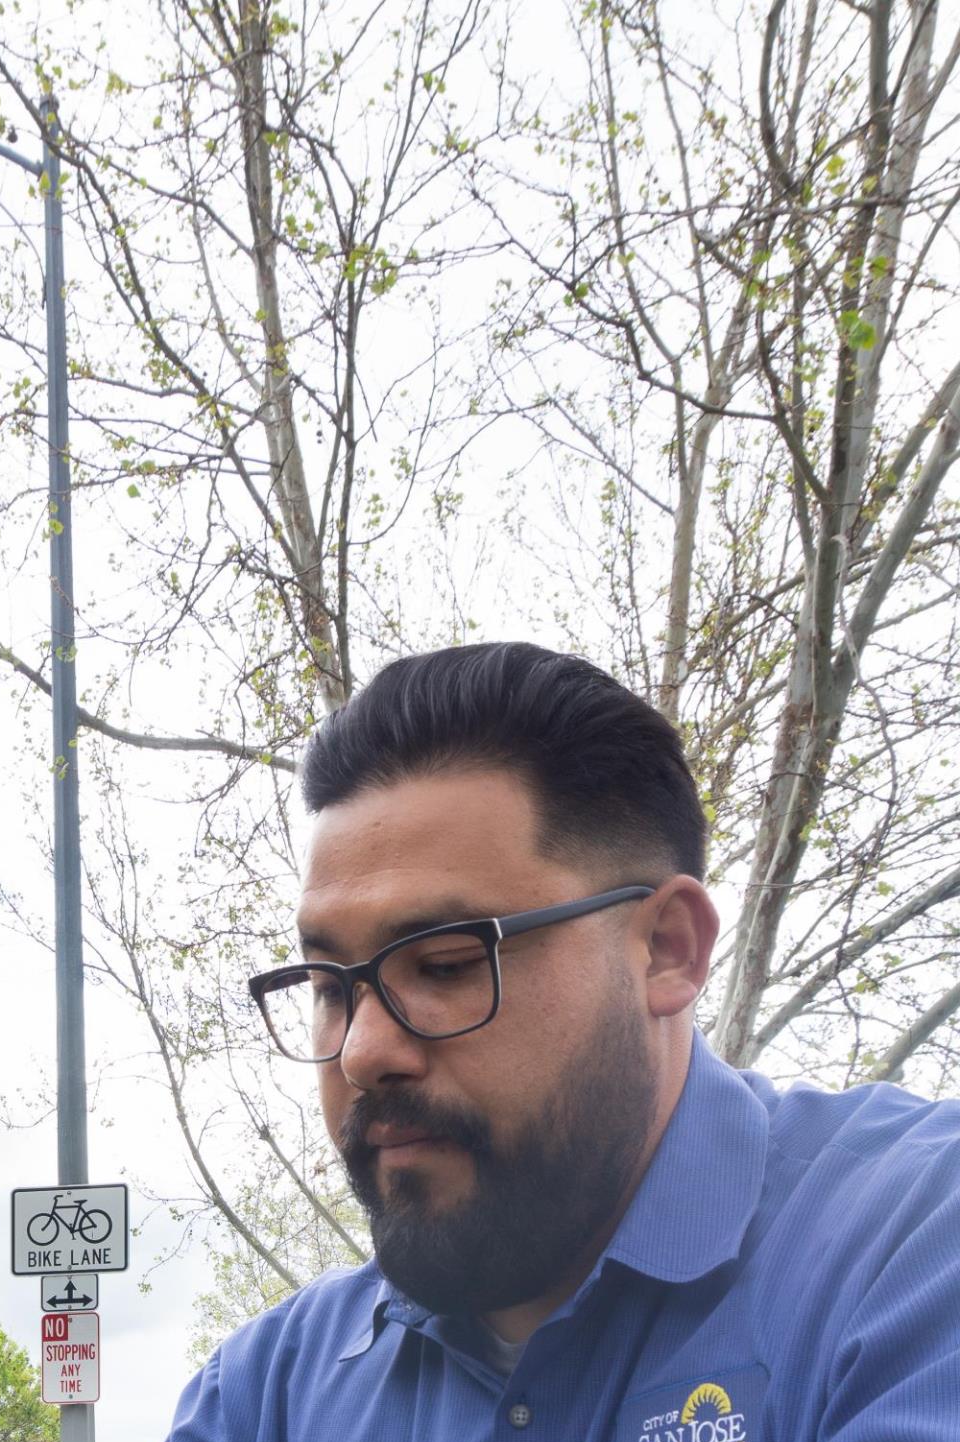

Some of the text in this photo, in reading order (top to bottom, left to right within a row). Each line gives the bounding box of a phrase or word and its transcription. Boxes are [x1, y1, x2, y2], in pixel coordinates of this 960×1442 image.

[28, 1248, 112, 1268] BIKE LANE
[45, 1318, 65, 1338] NO
[46, 1344, 96, 1362] STOPPING
[61, 1364, 81, 1377] ANY
[59, 1380, 82, 1393] TIME
[643, 1410, 679, 1431] CITY OF
